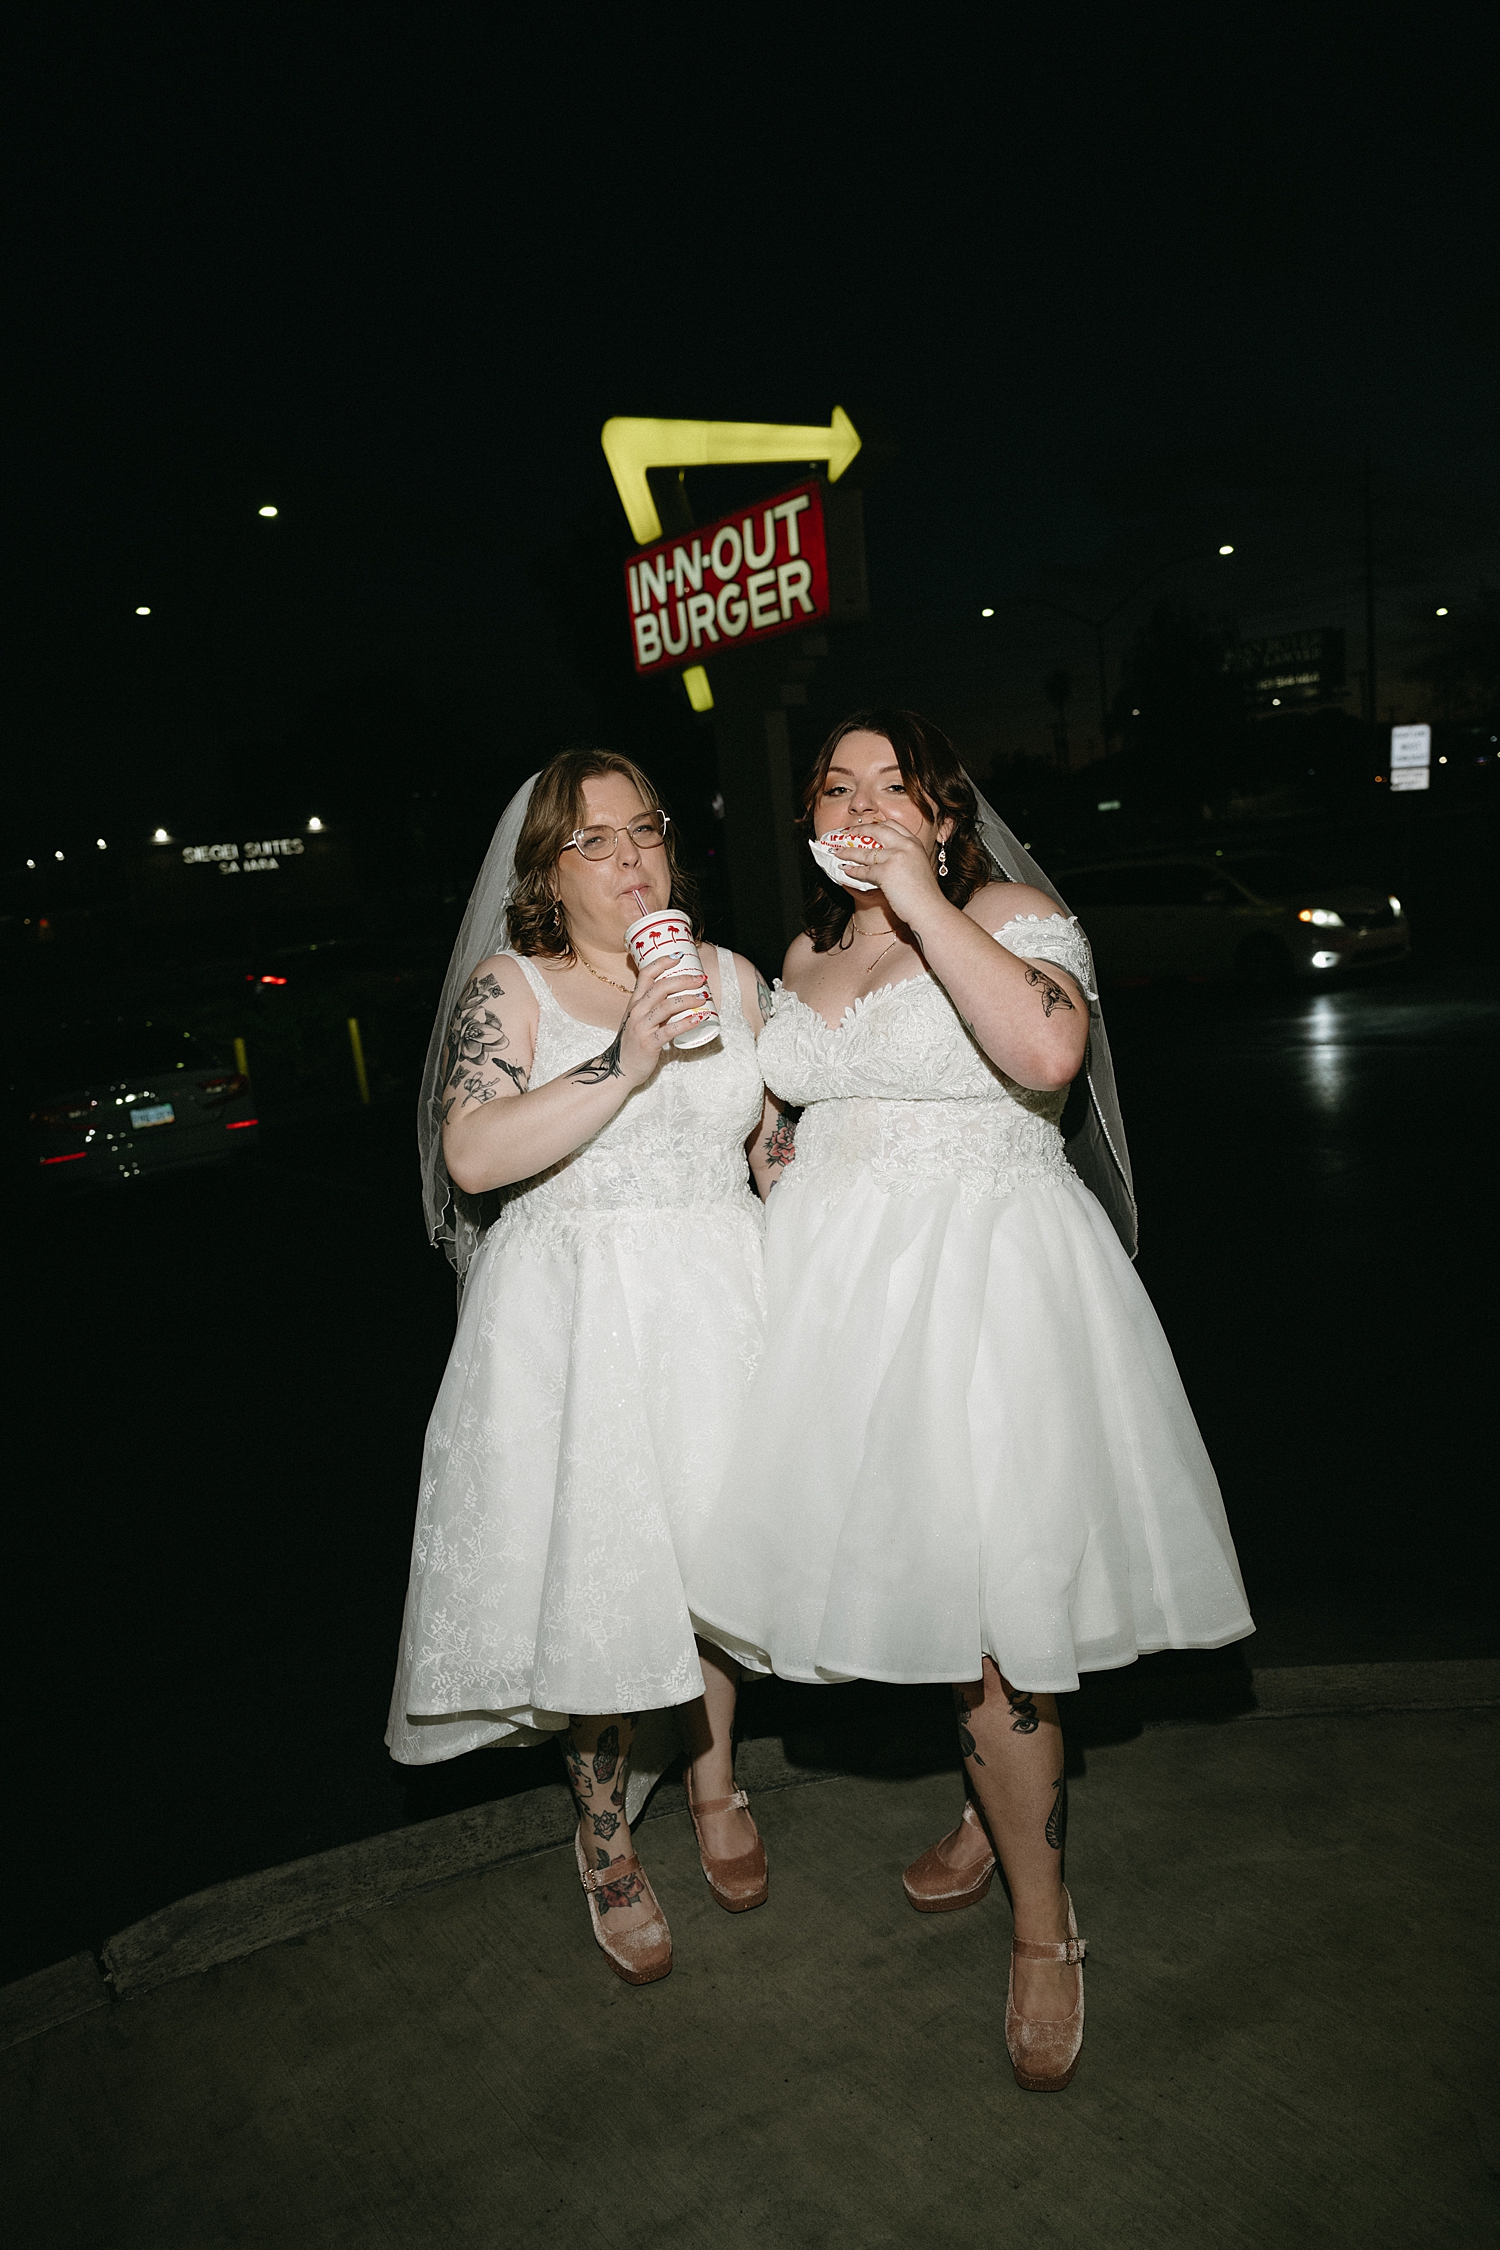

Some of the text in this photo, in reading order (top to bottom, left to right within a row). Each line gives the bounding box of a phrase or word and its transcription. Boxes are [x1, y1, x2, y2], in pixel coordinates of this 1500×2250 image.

[628, 494, 810, 614] IN-N-OUT
[634, 559, 815, 666] BURGER
[243, 837, 305, 858] SUITES
